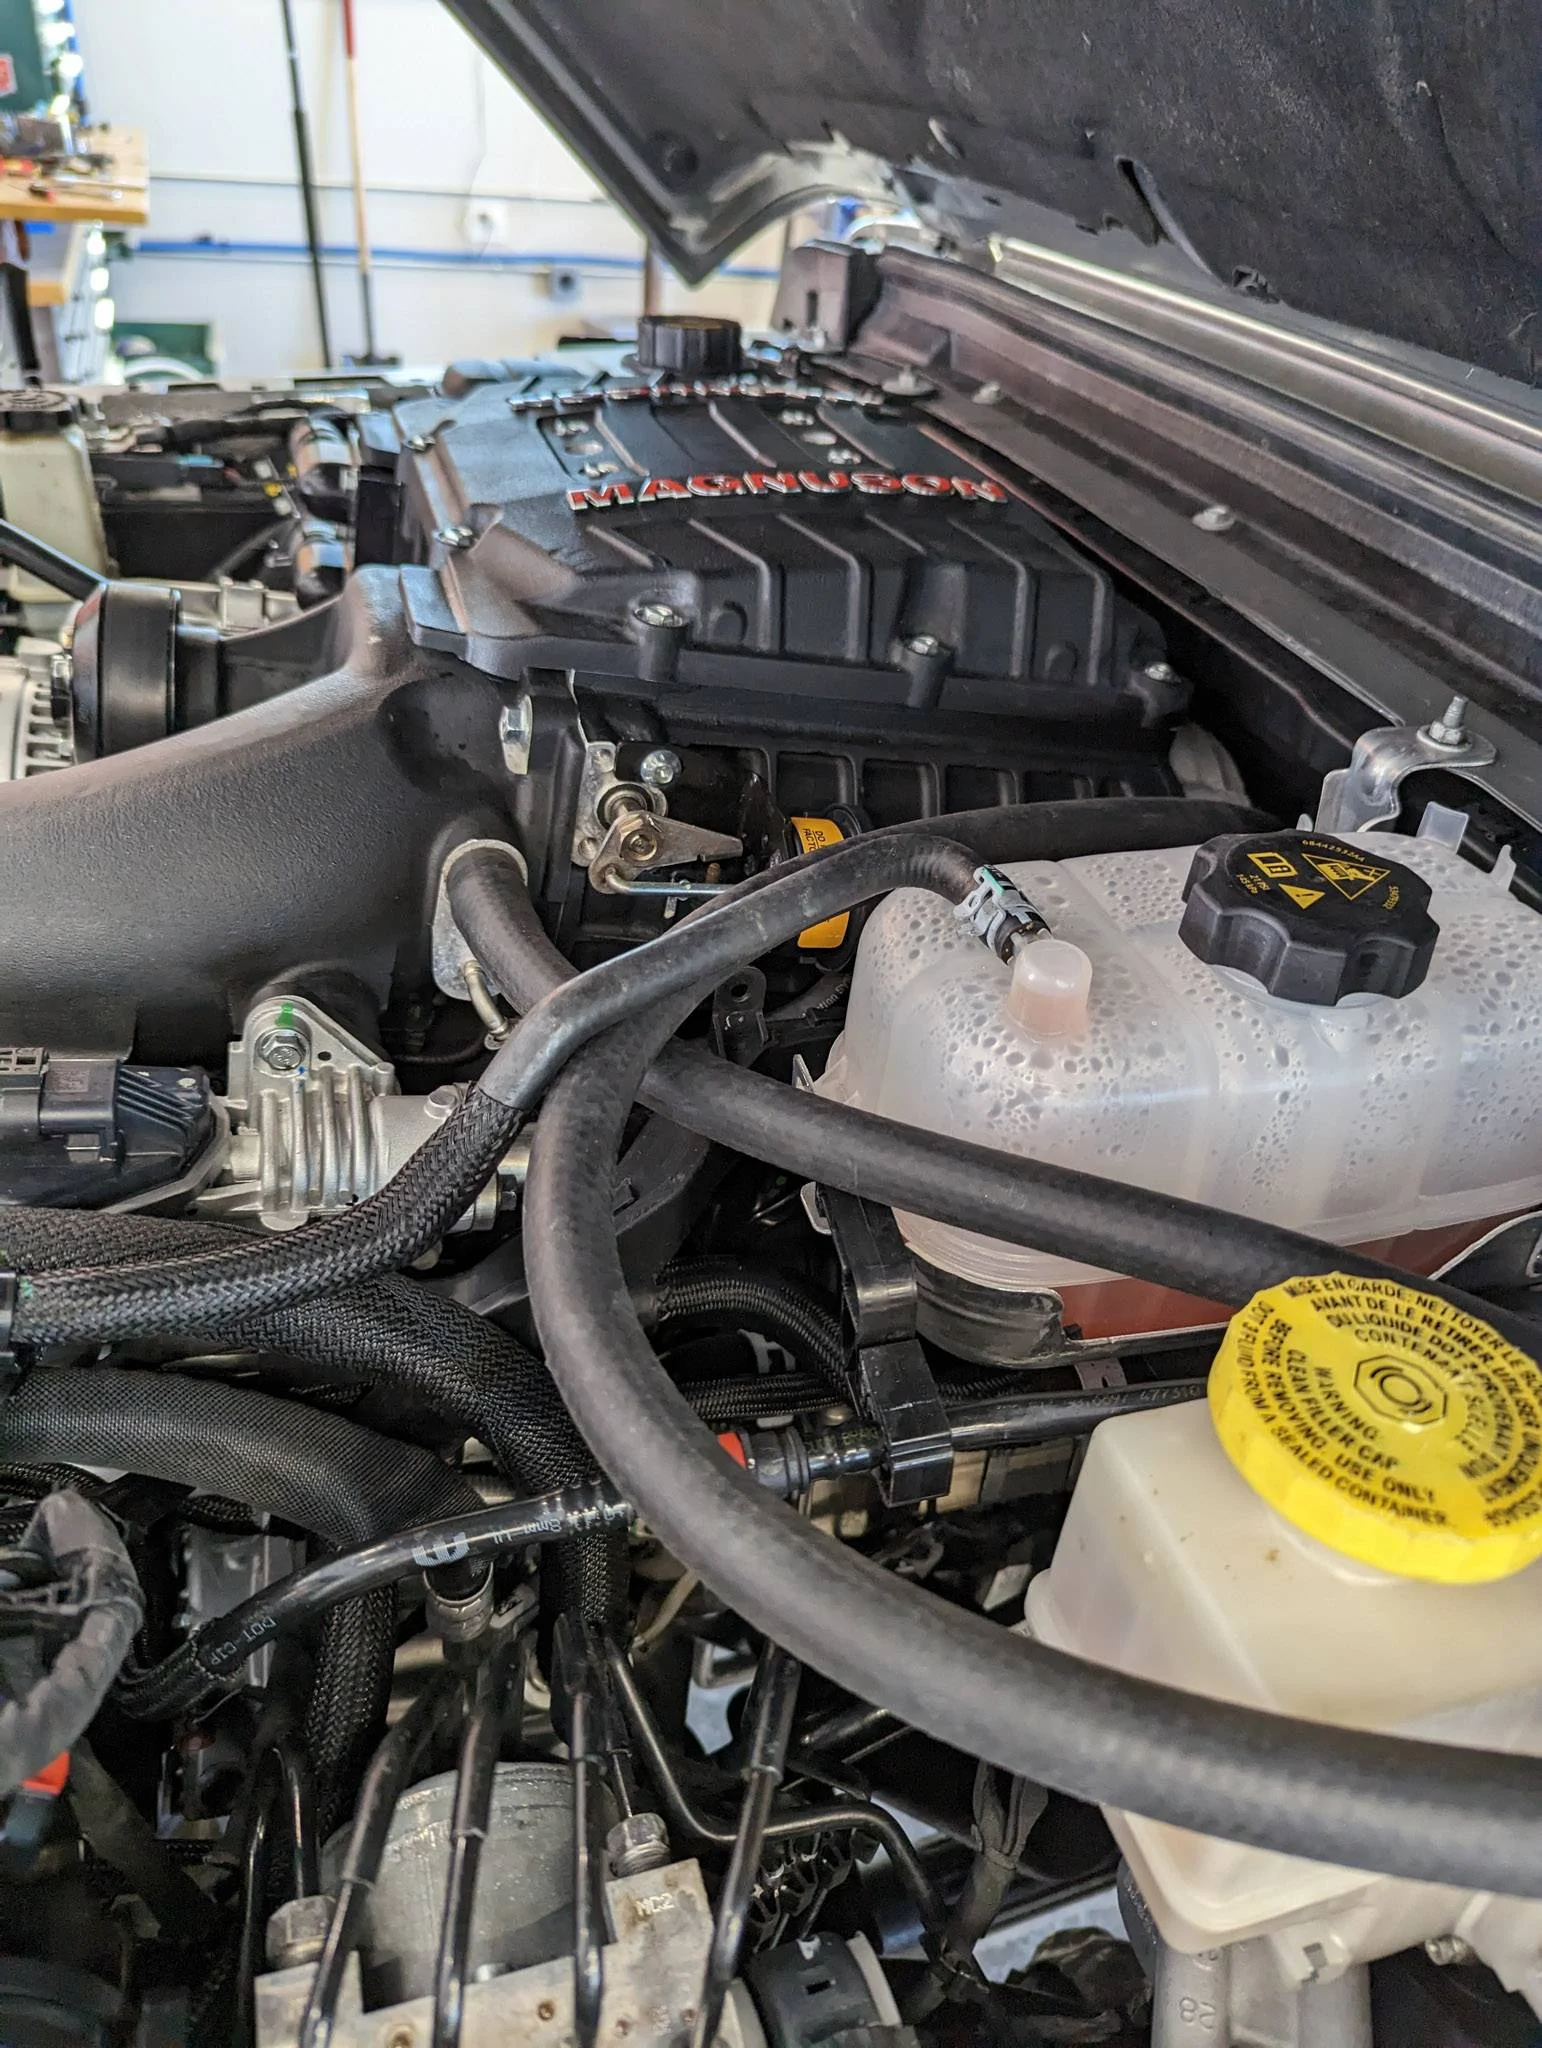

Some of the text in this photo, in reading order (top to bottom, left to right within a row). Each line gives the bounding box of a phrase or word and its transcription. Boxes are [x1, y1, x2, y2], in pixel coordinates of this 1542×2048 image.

[566, 470, 1009, 511] MAGNUSON
[1284, 1279, 1321, 1297] MISE
[1322, 1278, 1345, 1291] EN
[1416, 1295, 1504, 1349] NETTOYER
[1311, 1295, 1361, 1311] AVANT
[1366, 1296, 1388, 1311] DE
[1394, 1303, 1415, 1318] LE
[1352, 1312, 1421, 1336] LIQUIDE
[1428, 1334, 1464, 1359] DOT
[1240, 1369, 1271, 1410] FROM
[1260, 1412, 1277, 1424] A
[1270, 1425, 1335, 1480] SEALED
[1262, 1318, 1293, 1368] BEFORE
[1334, 1453, 1375, 1482] USE
[1381, 1476, 1436, 1502] ONLY
[1287, 1349, 1398, 1470] CLEAN FILLER CAP
